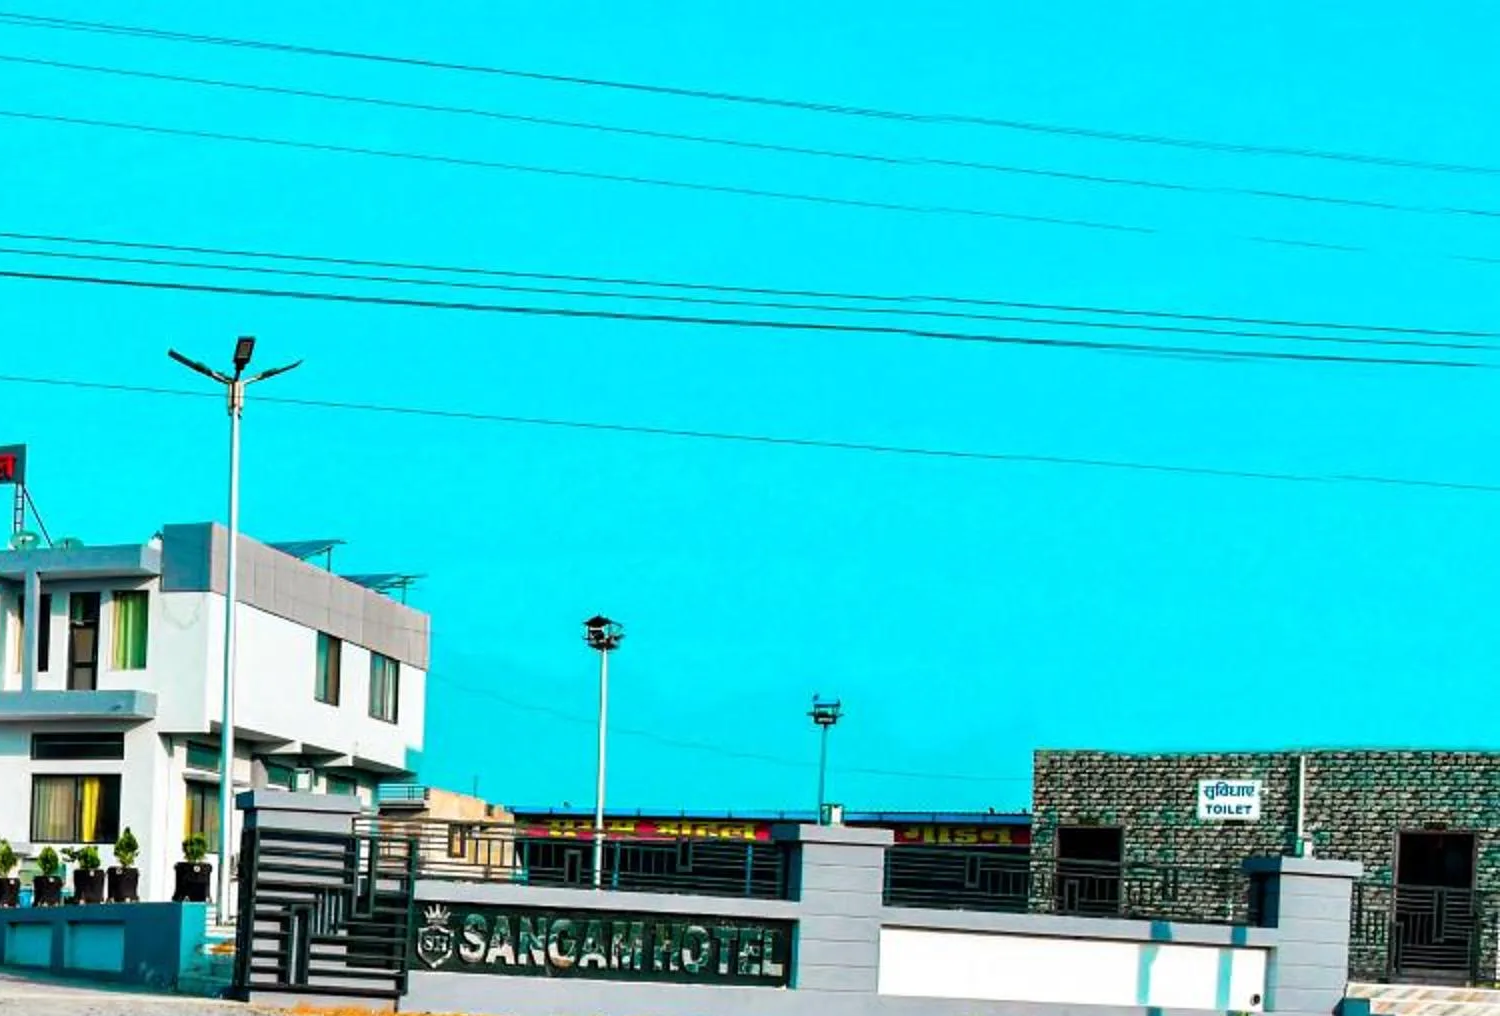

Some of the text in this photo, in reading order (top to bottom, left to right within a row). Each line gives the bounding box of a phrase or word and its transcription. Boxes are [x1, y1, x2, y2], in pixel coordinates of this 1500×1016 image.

[1206, 804, 1252, 814] TOILET
[459, 913, 784, 977] SANGAM HOTEL
